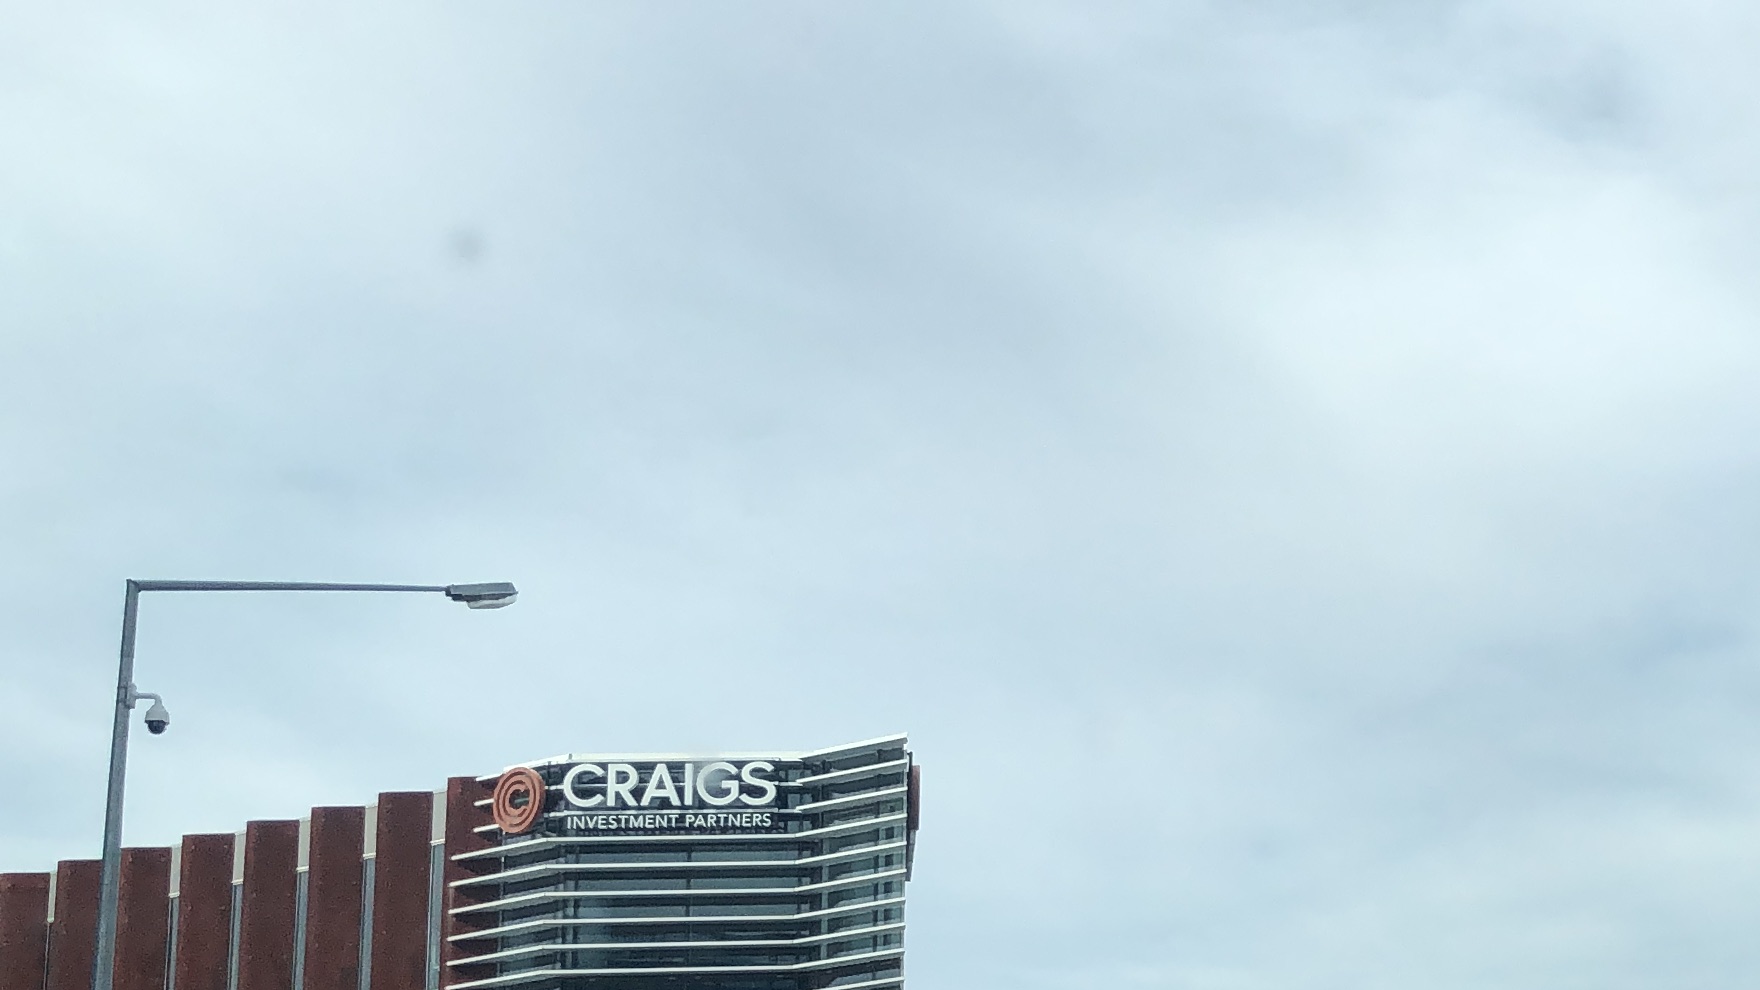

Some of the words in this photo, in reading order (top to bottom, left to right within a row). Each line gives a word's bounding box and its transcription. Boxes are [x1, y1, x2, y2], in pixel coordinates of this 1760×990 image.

[563, 761, 777, 807] CRAIGS
[567, 815, 678, 830] INVESTMENT
[685, 813, 772, 829] PARTNERS
